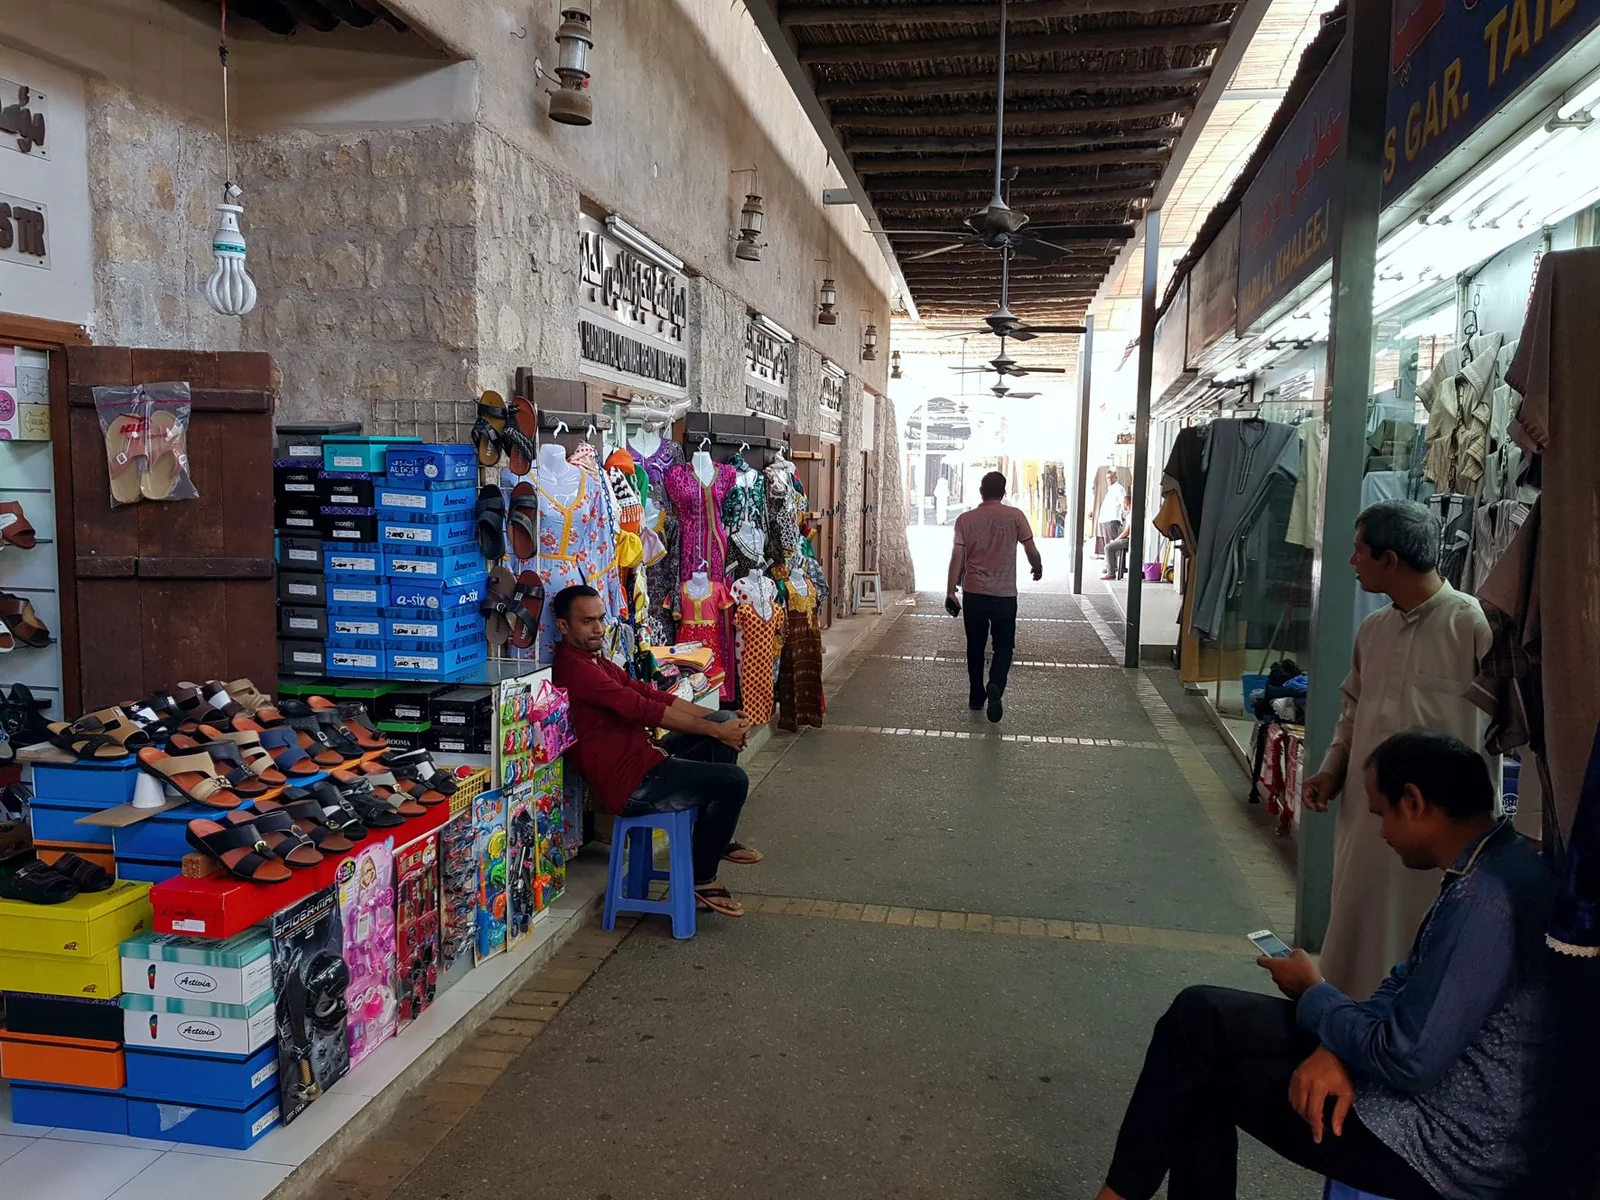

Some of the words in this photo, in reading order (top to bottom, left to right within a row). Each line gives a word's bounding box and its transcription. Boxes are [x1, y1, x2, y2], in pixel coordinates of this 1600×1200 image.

[1404, 57, 1470, 162] GAR.
[1275, 197, 1330, 287] KHALEEJ
[396, 594, 426, 606] a-six
[458, 588, 479, 605] a-six
[304, 924, 316, 940] 3
[179, 976, 212, 989] Activia
[183, 1025, 216, 1037] Activia
